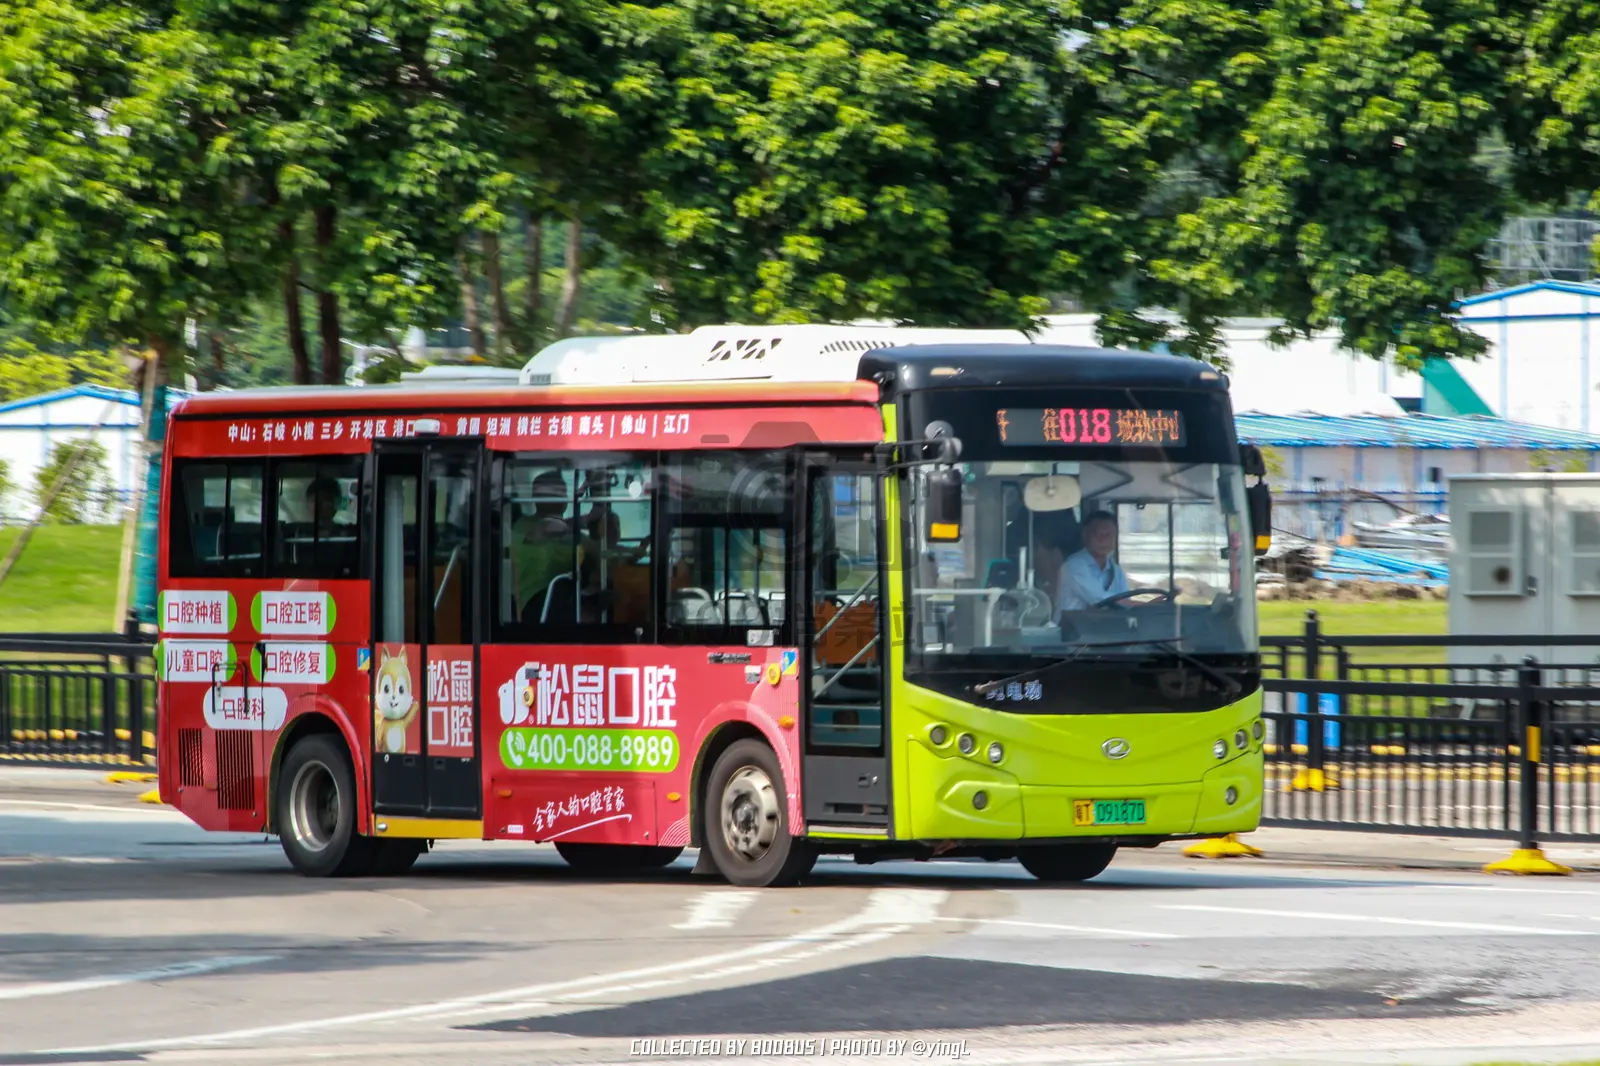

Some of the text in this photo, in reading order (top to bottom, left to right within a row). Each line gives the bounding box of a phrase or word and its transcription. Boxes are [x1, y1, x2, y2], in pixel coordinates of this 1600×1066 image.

[263, 422, 286, 442] 石岐
[321, 420, 344, 440] 三乡
[350, 419, 387, 439] 开发区
[392, 418, 417, 438] 港口
[486, 416, 511, 436] 坦洲
[548, 415, 573, 436] 古镇
[578, 414, 604, 436] 南头
[621, 414, 647, 436] 佛山
[663, 413, 690, 434] 江门
[1059, 408, 1112, 442] 018
[167, 600, 222, 625] 口腔种植
[265, 602, 321, 626] 口腔正畸
[168, 649, 223, 673] 儿童口腔
[264, 650, 321, 675] 口腔修复
[427, 659, 472, 702] 松鼠
[537, 663, 677, 728] 松鼠口腔
[222, 697, 266, 721] 口腔科
[427, 705, 473, 748] 口腔
[526, 733, 674, 767] 400-088-8989
[532, 785, 625, 833] 全家人的口腔管家
